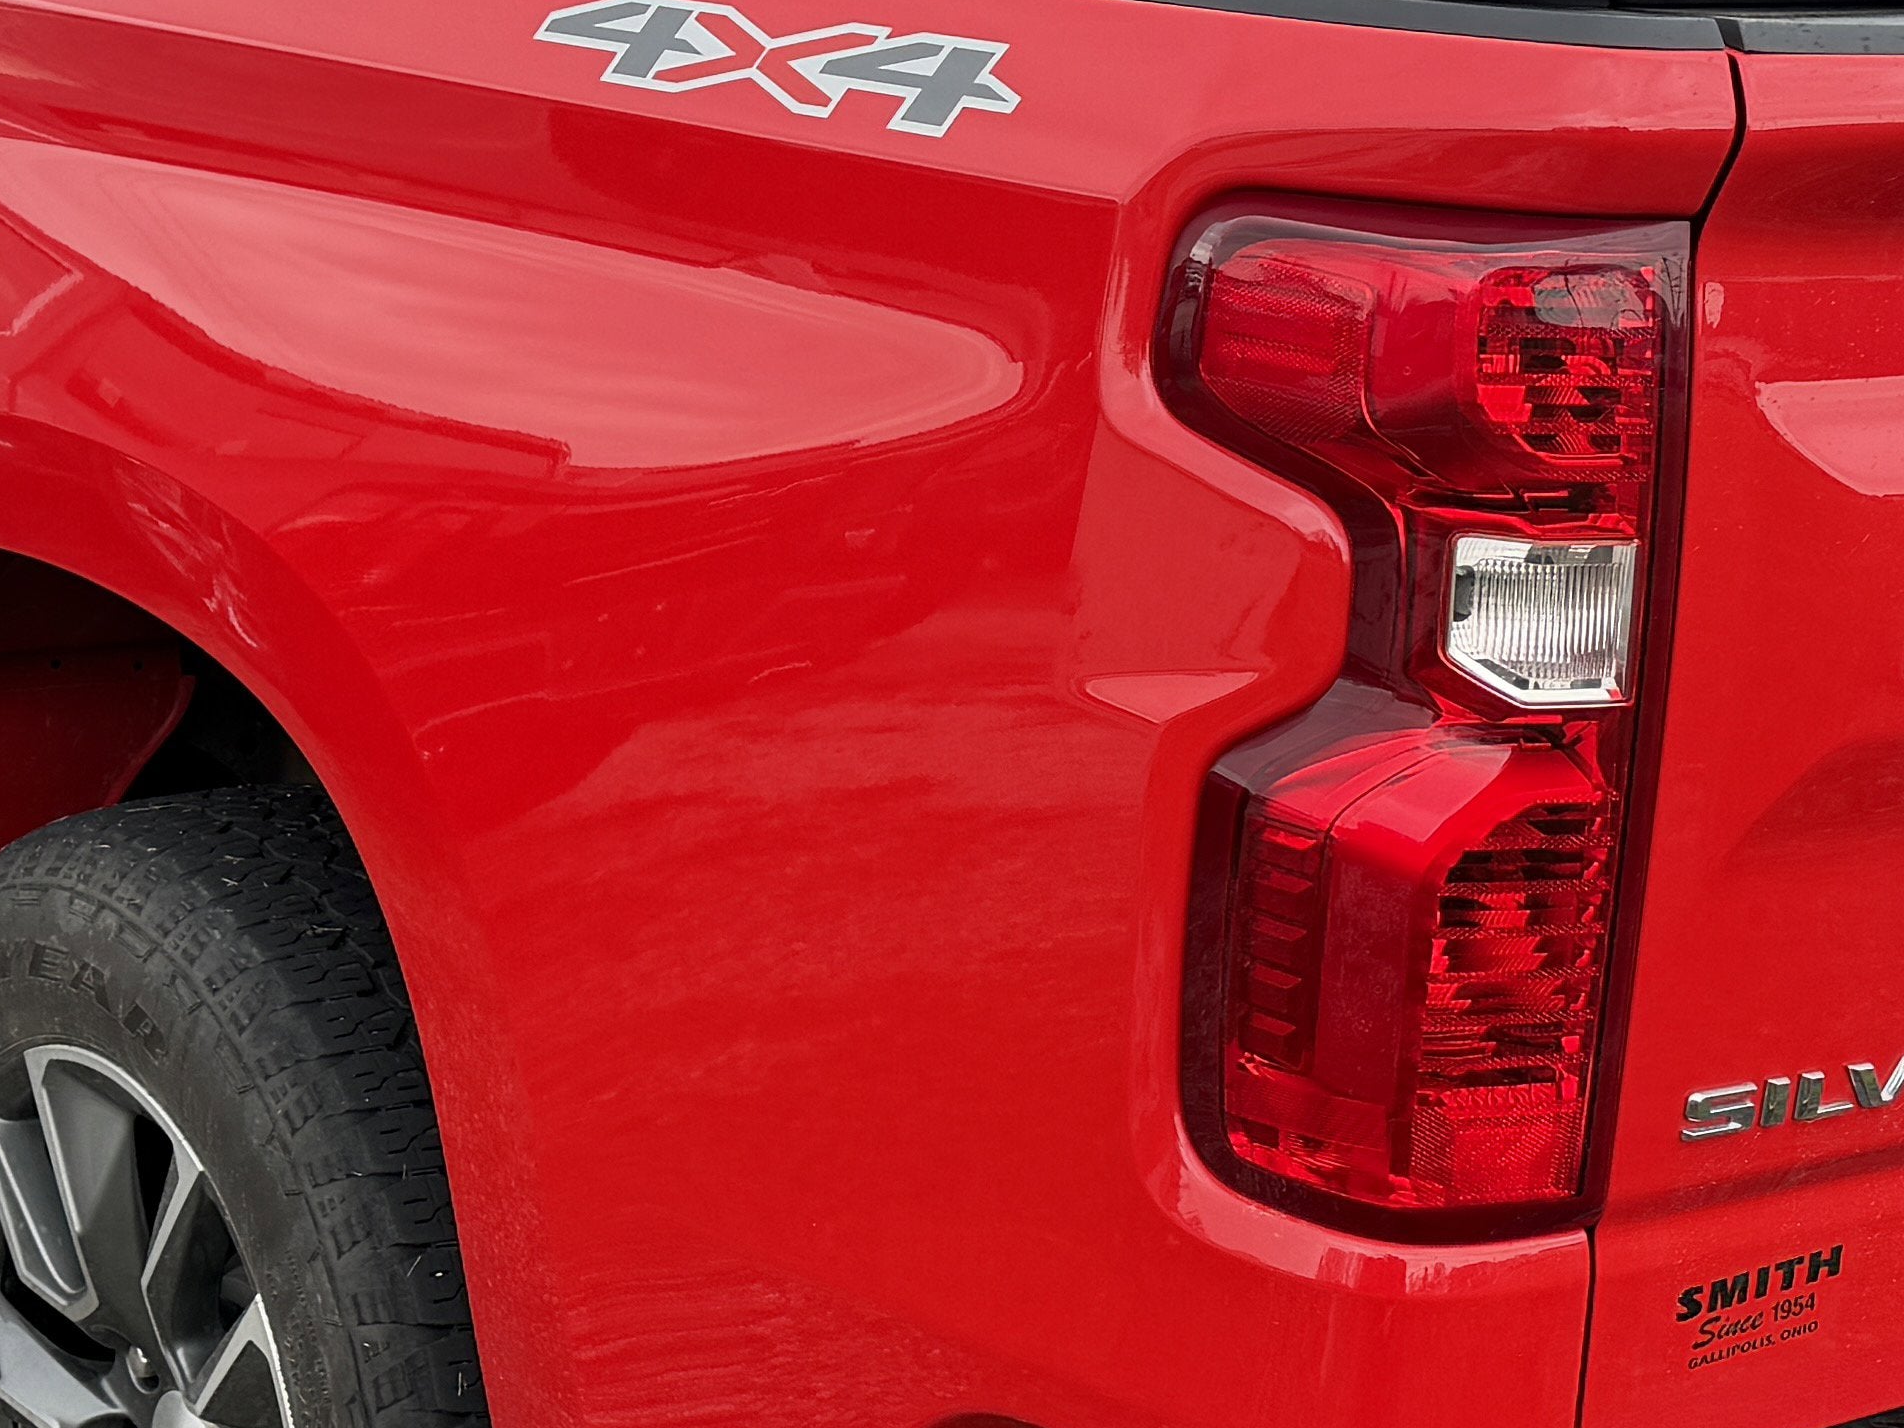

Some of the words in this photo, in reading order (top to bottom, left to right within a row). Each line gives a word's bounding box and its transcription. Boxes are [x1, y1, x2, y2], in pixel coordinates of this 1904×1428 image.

[1676, 1244, 1843, 1322] SMITH
[1692, 1312, 1764, 1350] Since
[1770, 1292, 1817, 1323] 1954
[1779, 1320, 1819, 1341] OHIO
